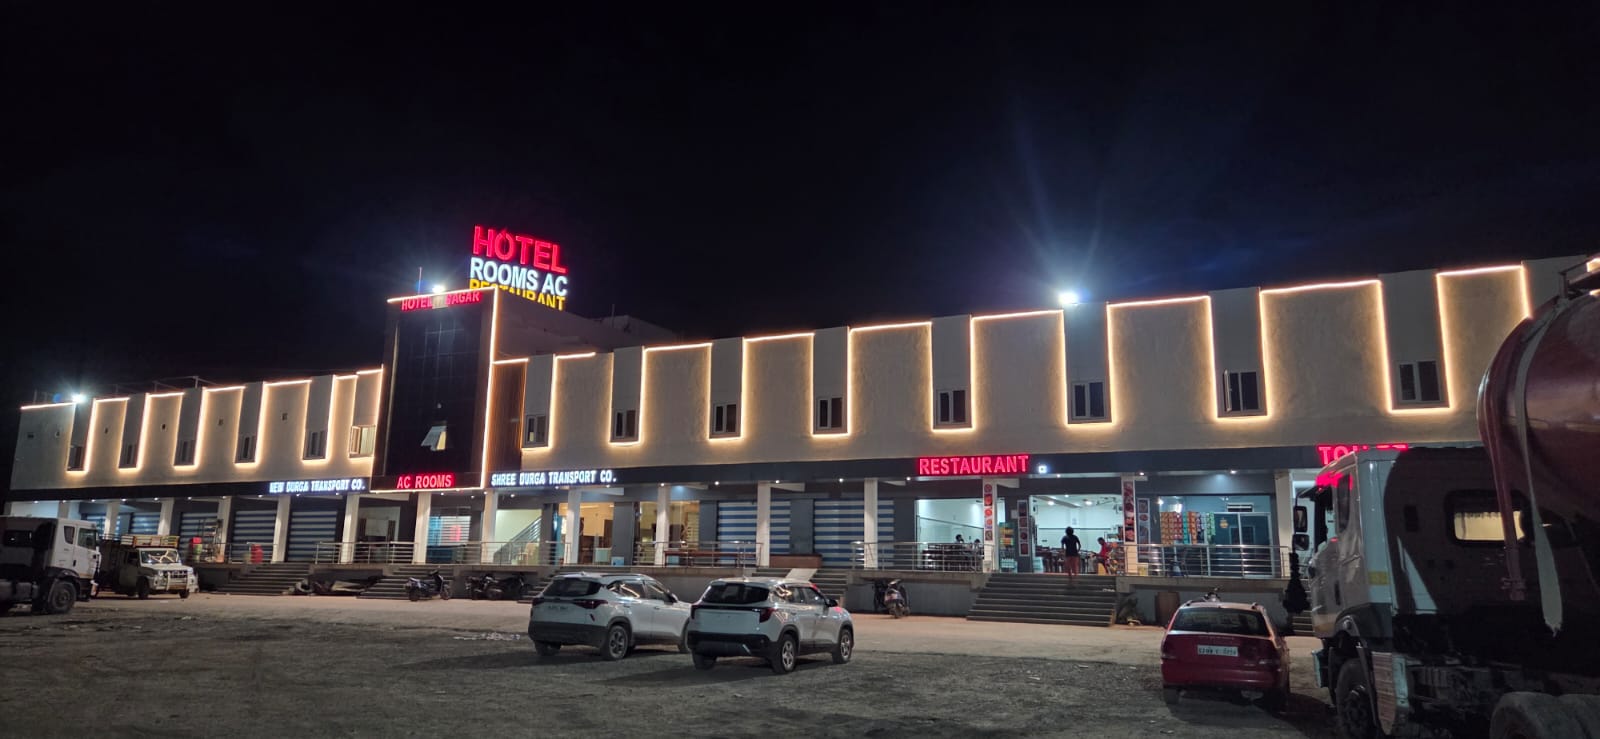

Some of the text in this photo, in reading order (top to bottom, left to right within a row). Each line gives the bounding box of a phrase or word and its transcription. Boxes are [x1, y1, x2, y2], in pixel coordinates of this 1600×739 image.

[473, 225, 567, 273] HOTEL
[470, 256, 568, 296] ROOMS AC
[401, 295, 433, 311] HOTEL
[469, 278, 566, 311] RRANT
[919, 455, 1029, 475] RESTAURANT
[286, 481, 309, 493] DURGA
[311, 479, 350, 491] TRANSPORT
[351, 478, 366, 490] CO.
[396, 474, 452, 489] AC ROOMS
[491, 469, 617, 486] SHREE DURGA TRANSPORT CO.
